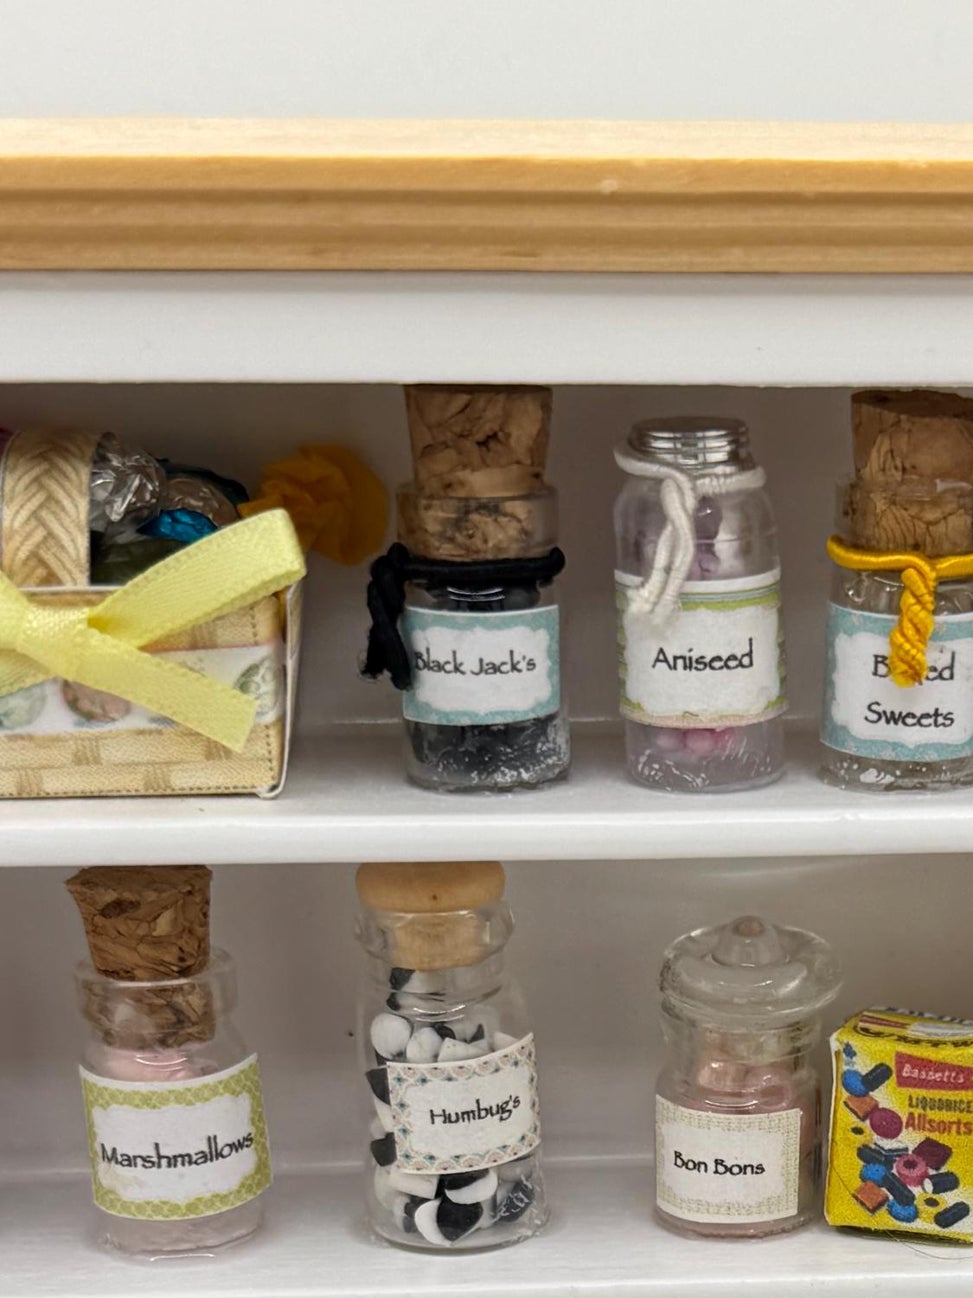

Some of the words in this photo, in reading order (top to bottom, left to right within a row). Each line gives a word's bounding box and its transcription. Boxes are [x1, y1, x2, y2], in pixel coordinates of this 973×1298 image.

[414, 647, 466, 675] Black
[470, 649, 537, 676] Jack's
[652, 637, 754, 672] Aniseed
[872, 650, 956, 682] Bed
[864, 701, 955, 728] Sweets
[430, 1094, 521, 1126] Humbug's
[904, 1112, 973, 1136] Allsorts
[100, 1133, 255, 1170] Marshmallows
[673, 1150, 709, 1173] Bon
[713, 1158, 766, 1177] Bons
